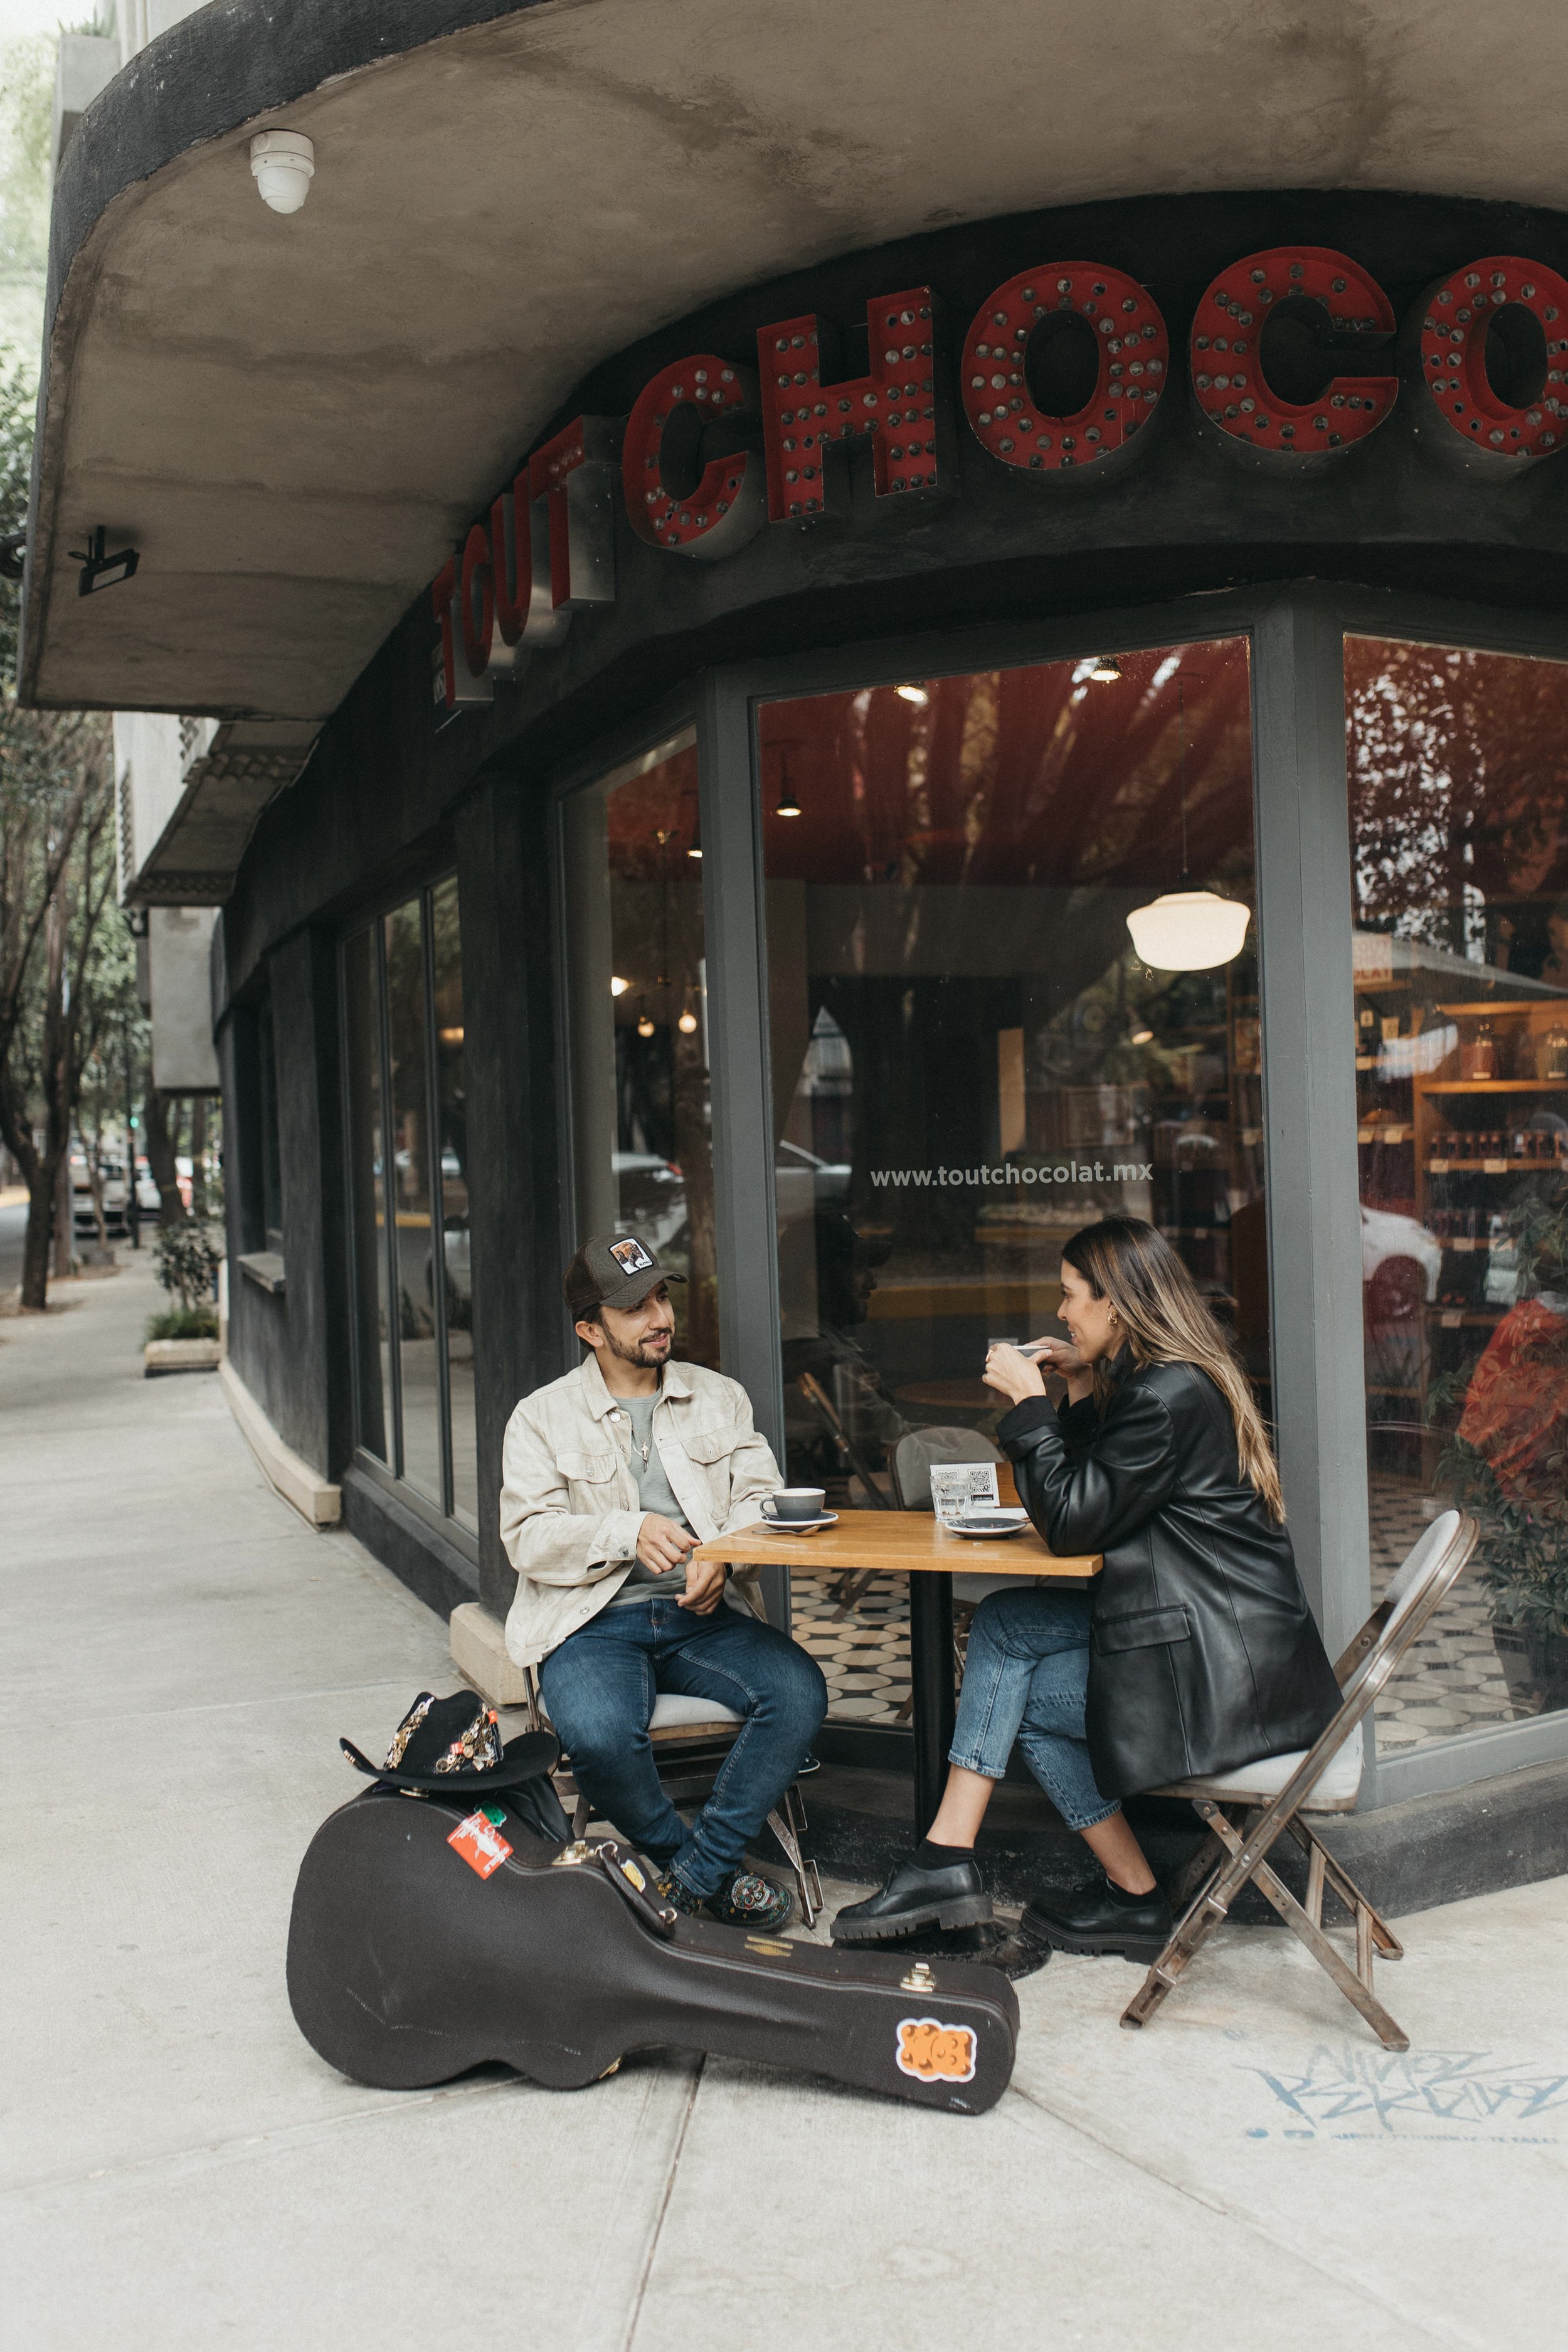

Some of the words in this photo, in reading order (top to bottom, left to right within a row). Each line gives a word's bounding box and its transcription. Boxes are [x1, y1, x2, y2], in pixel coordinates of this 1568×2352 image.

[433, 415, 585, 710] TOUT
[622, 245, 1568, 548] CHOCO
[870, 1161, 1154, 1187] www.toutchocolat.mx
